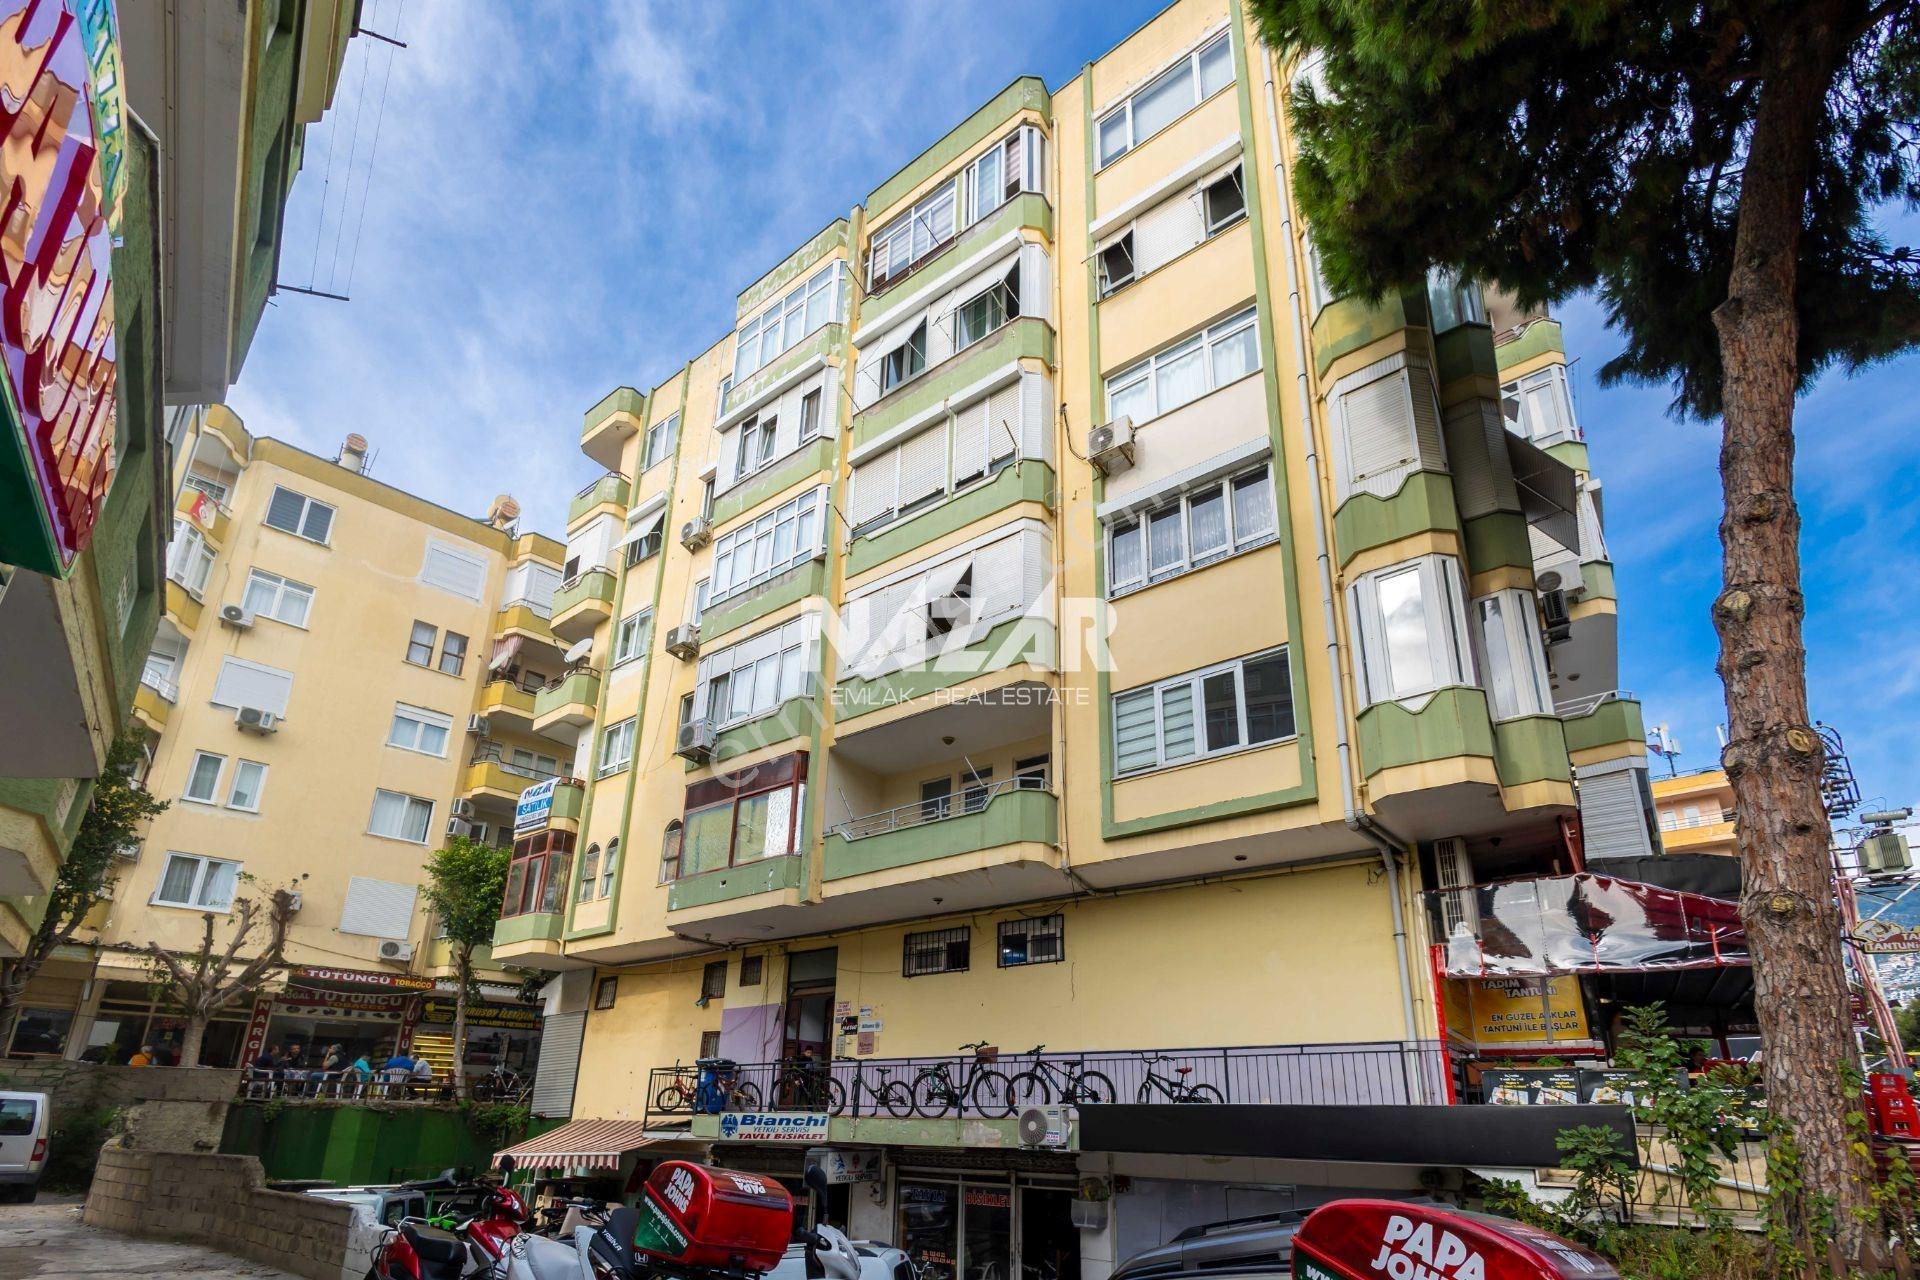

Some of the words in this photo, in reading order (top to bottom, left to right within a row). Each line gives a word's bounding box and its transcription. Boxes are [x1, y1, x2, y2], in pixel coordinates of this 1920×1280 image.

[308, 969, 391, 985] TÜTÜNCÜ
[394, 978, 432, 990] TOBACCO
[1482, 979, 1520, 989] TADIM
[1491, 1013, 1503, 1021] EN
[1539, 1010, 1577, 1020] AKLAR
[1483, 1022, 1523, 1033] TANTUNİ
[1524, 1022, 1538, 1031] İLE
[740, 1114, 828, 1127] Bianchi
[753, 1126, 780, 1134] YETKİLİ
[781, 1126, 810, 1134] SERVİSİ
[670, 1167, 695, 1198] PAPA
[663, 1183, 690, 1214] JOHNS
[1383, 1215, 1486, 1280] PAPA
